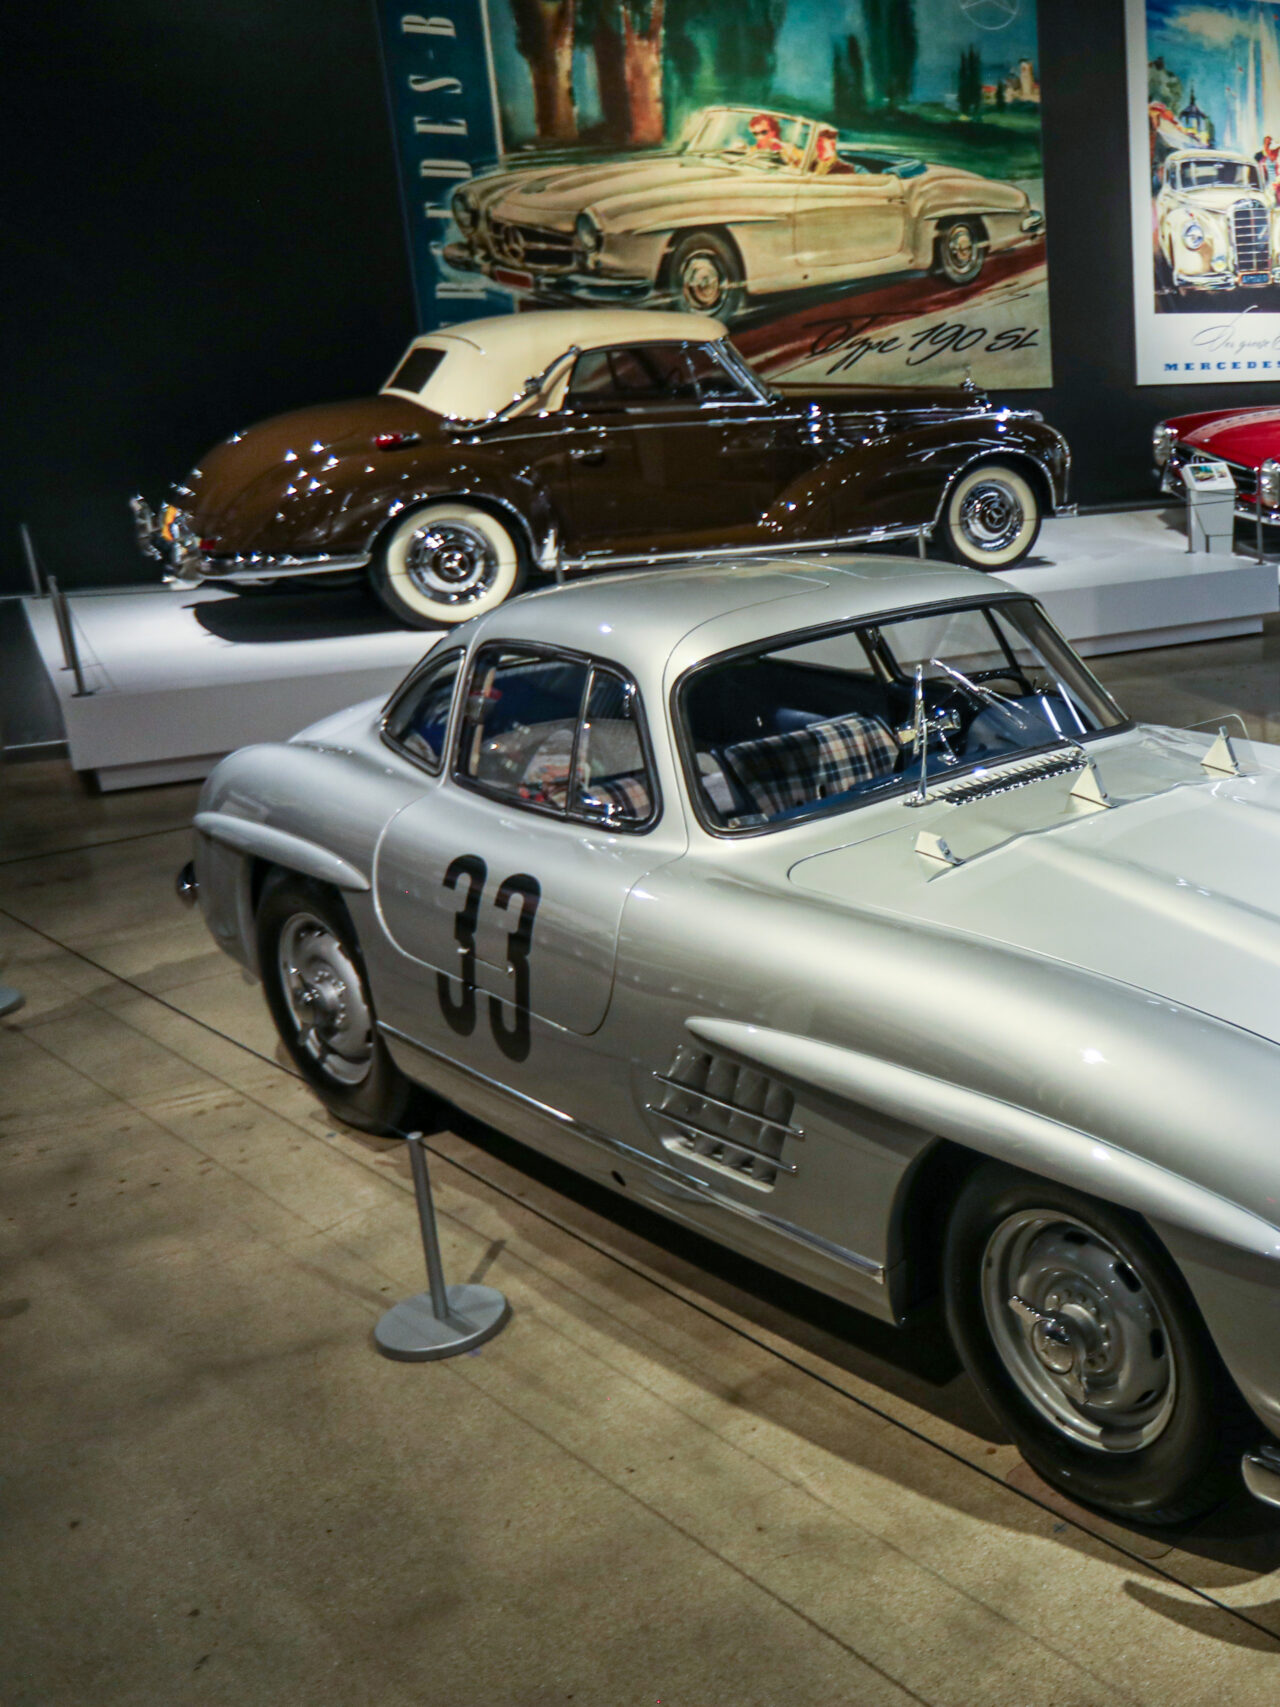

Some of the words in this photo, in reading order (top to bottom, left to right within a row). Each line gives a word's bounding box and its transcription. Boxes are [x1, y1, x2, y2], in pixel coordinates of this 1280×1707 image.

[906, 321, 988, 366] 190
[985, 327, 1039, 352] SL
[437, 854, 542, 1063] 33
